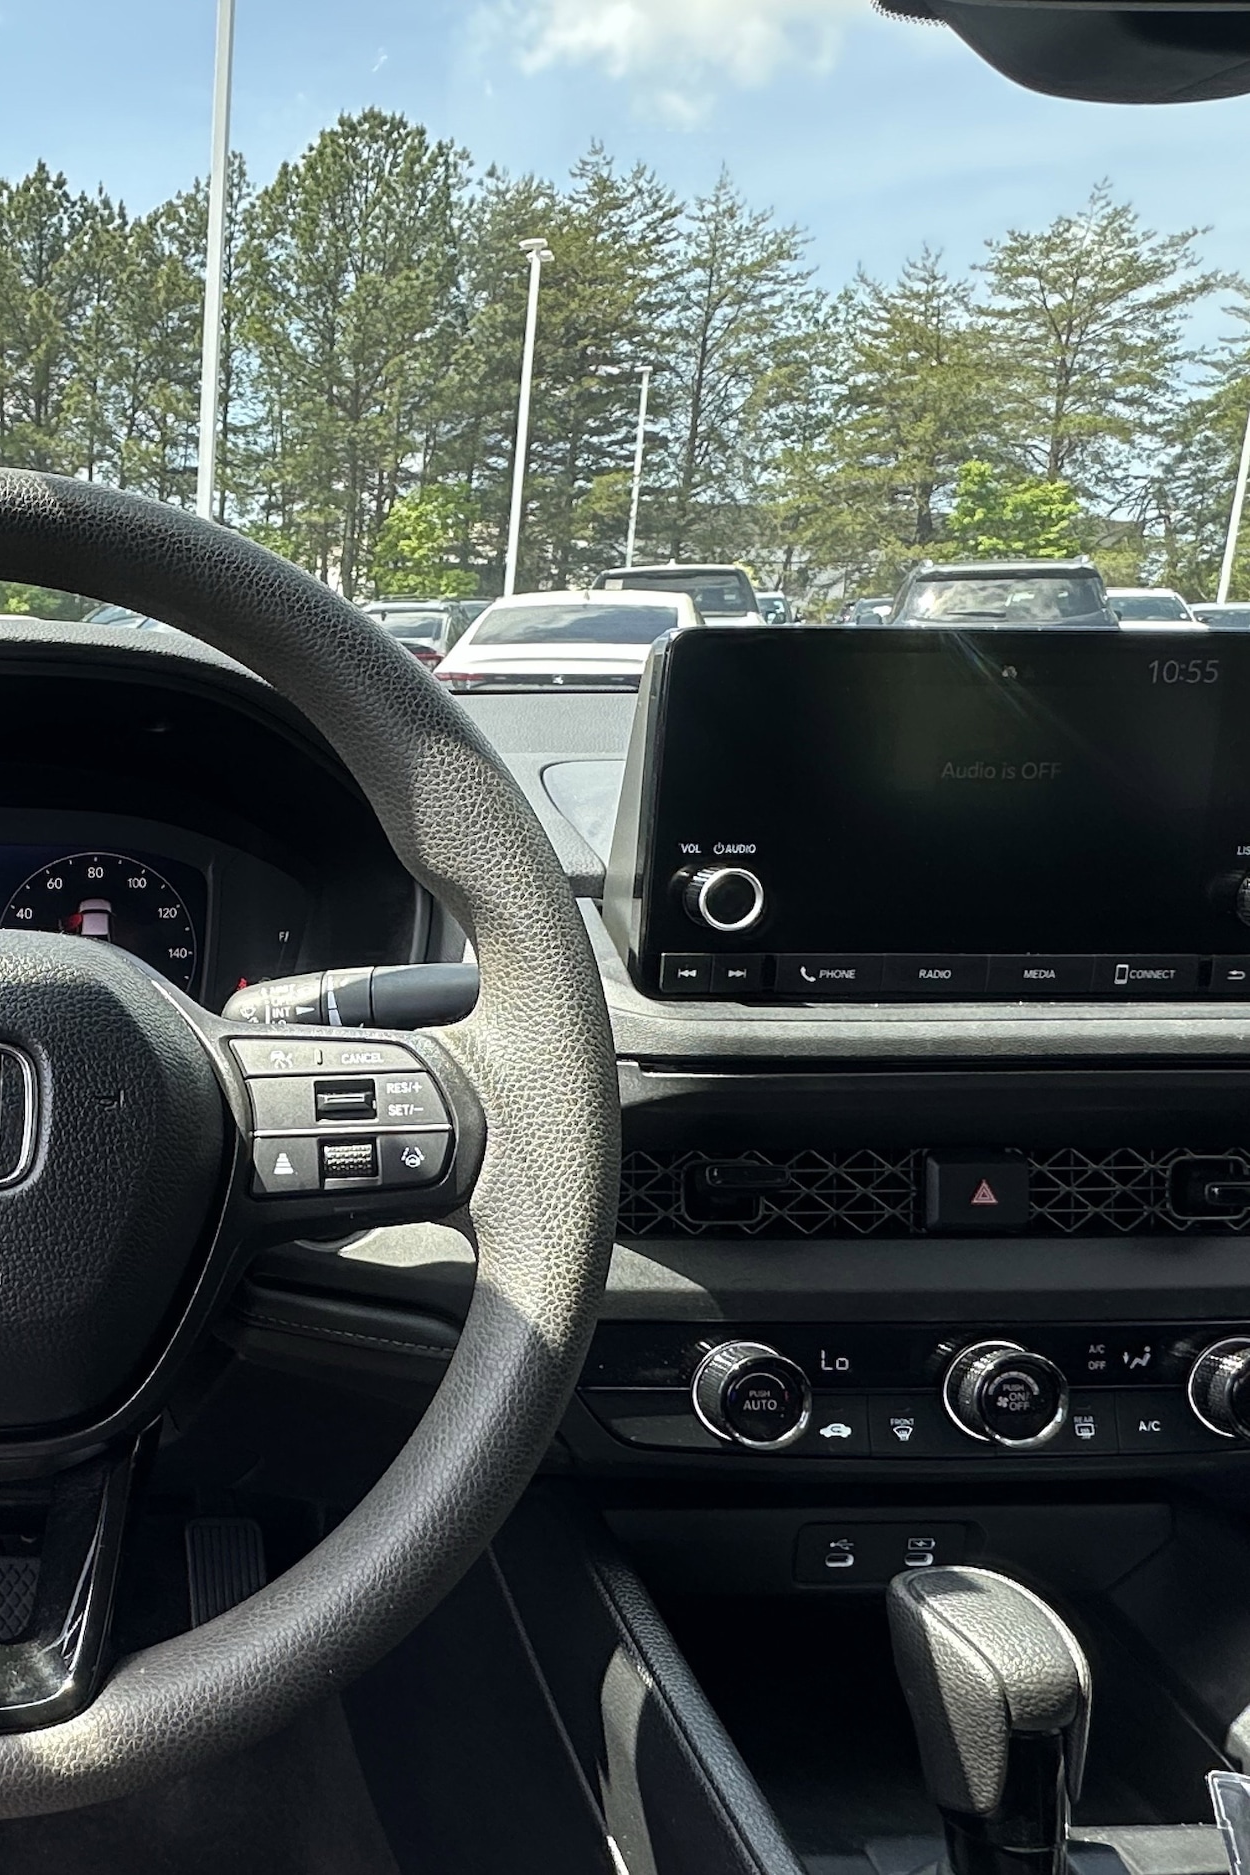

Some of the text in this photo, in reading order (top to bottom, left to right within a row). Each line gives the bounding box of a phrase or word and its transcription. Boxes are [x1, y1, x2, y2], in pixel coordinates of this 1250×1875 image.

[1148, 659, 1220, 685] 10:55
[941, 761, 1061, 780] Audio is OFF
[680, 843, 702, 855] VOL
[725, 843, 756, 855] AUDIO
[87, 867, 104, 879] 80
[46, 878, 63, 890] 60
[127, 878, 147, 889] 100
[15, 908, 33, 920] 40
[157, 907, 178, 919] 120
[168, 948, 188, 959] 140
[819, 968, 856, 980] PHONE
[918, 968, 952, 980] RADIO
[1023, 968, 1056, 980] MEDIA
[1129, 968, 1176, 980] CONNECT
[271, 1006, 291, 1019] INT
[341, 1053, 384, 1065] CANCEL
[1088, 1344, 1106, 1354] A/C
[1087, 1360, 1106, 1371] OFF
[749, 1390, 771, 1398] PUSH
[1003, 1384, 1024, 1392] PUSH
[743, 1400, 777, 1411] AUTO
[1008, 1401, 1030, 1411] OFF
[890, 1417, 915, 1426] FRONT
[1073, 1415, 1094, 1423] REAR
[1138, 1420, 1161, 1432] A/C
